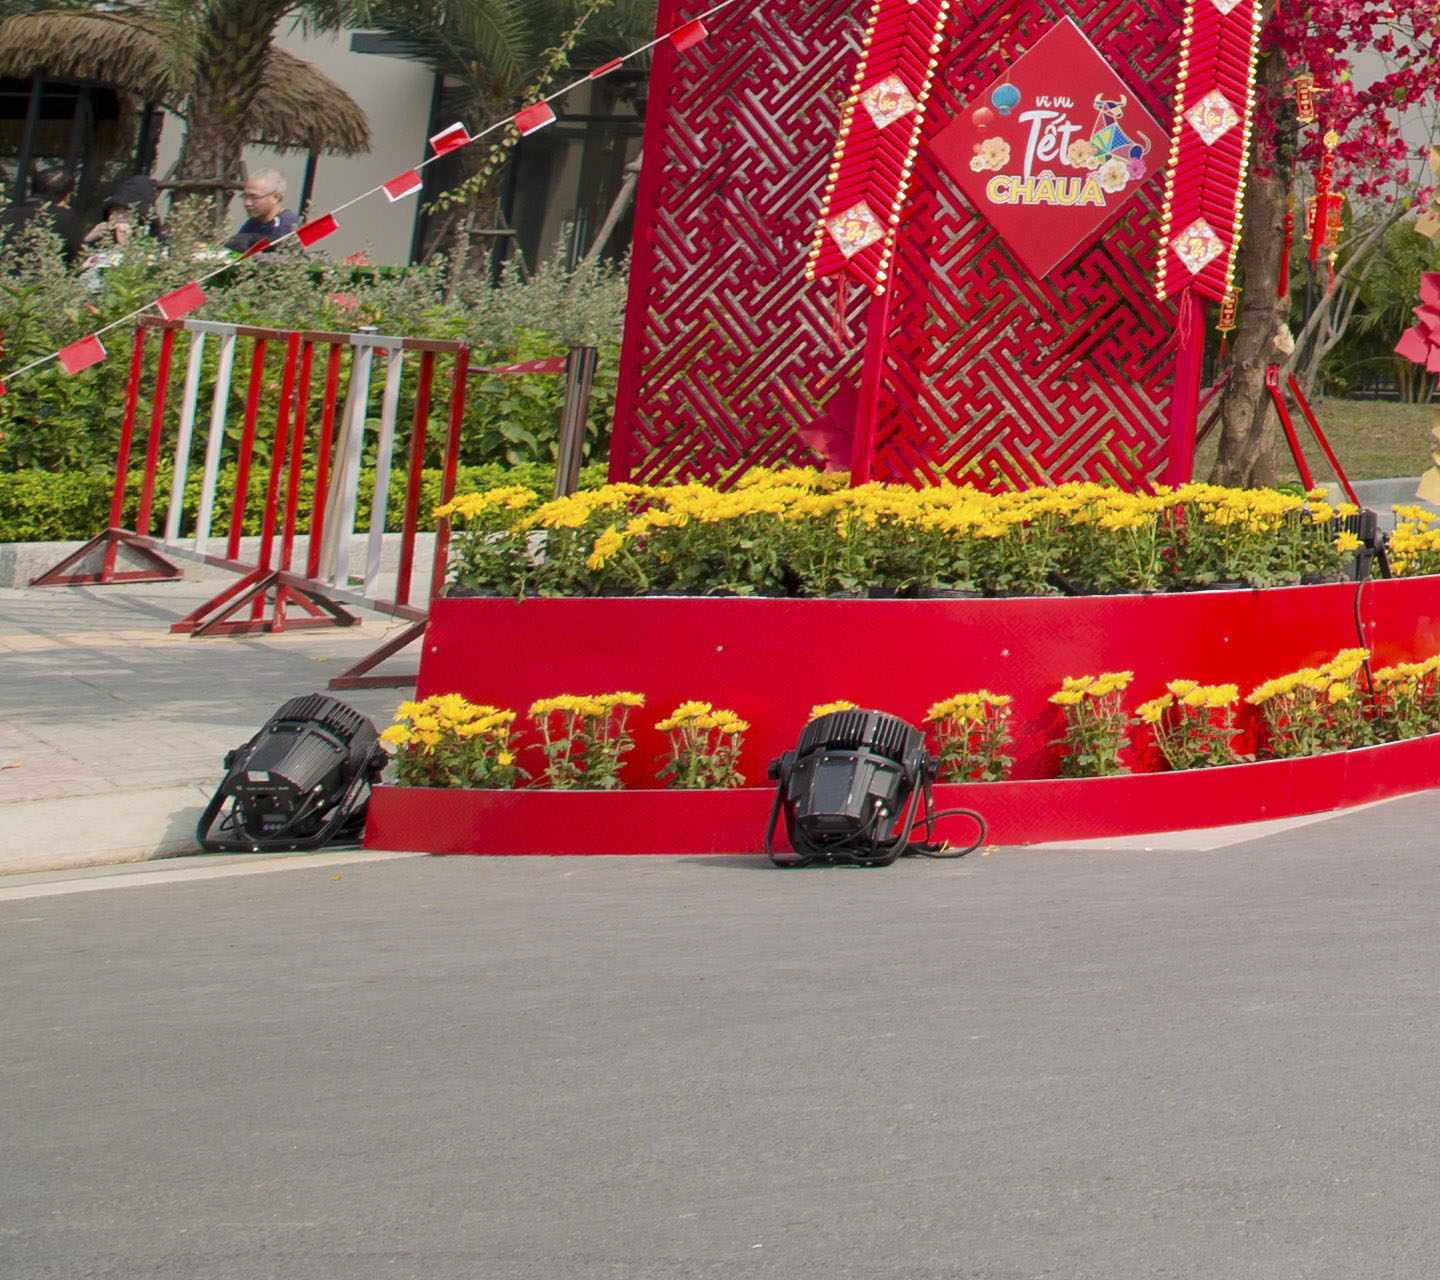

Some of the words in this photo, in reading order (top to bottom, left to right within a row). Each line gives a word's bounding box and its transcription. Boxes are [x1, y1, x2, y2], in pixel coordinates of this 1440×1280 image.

[1036, 96, 1051, 108] vi
[1053, 96, 1074, 108] vu
[1018, 110, 1083, 180] Tết
